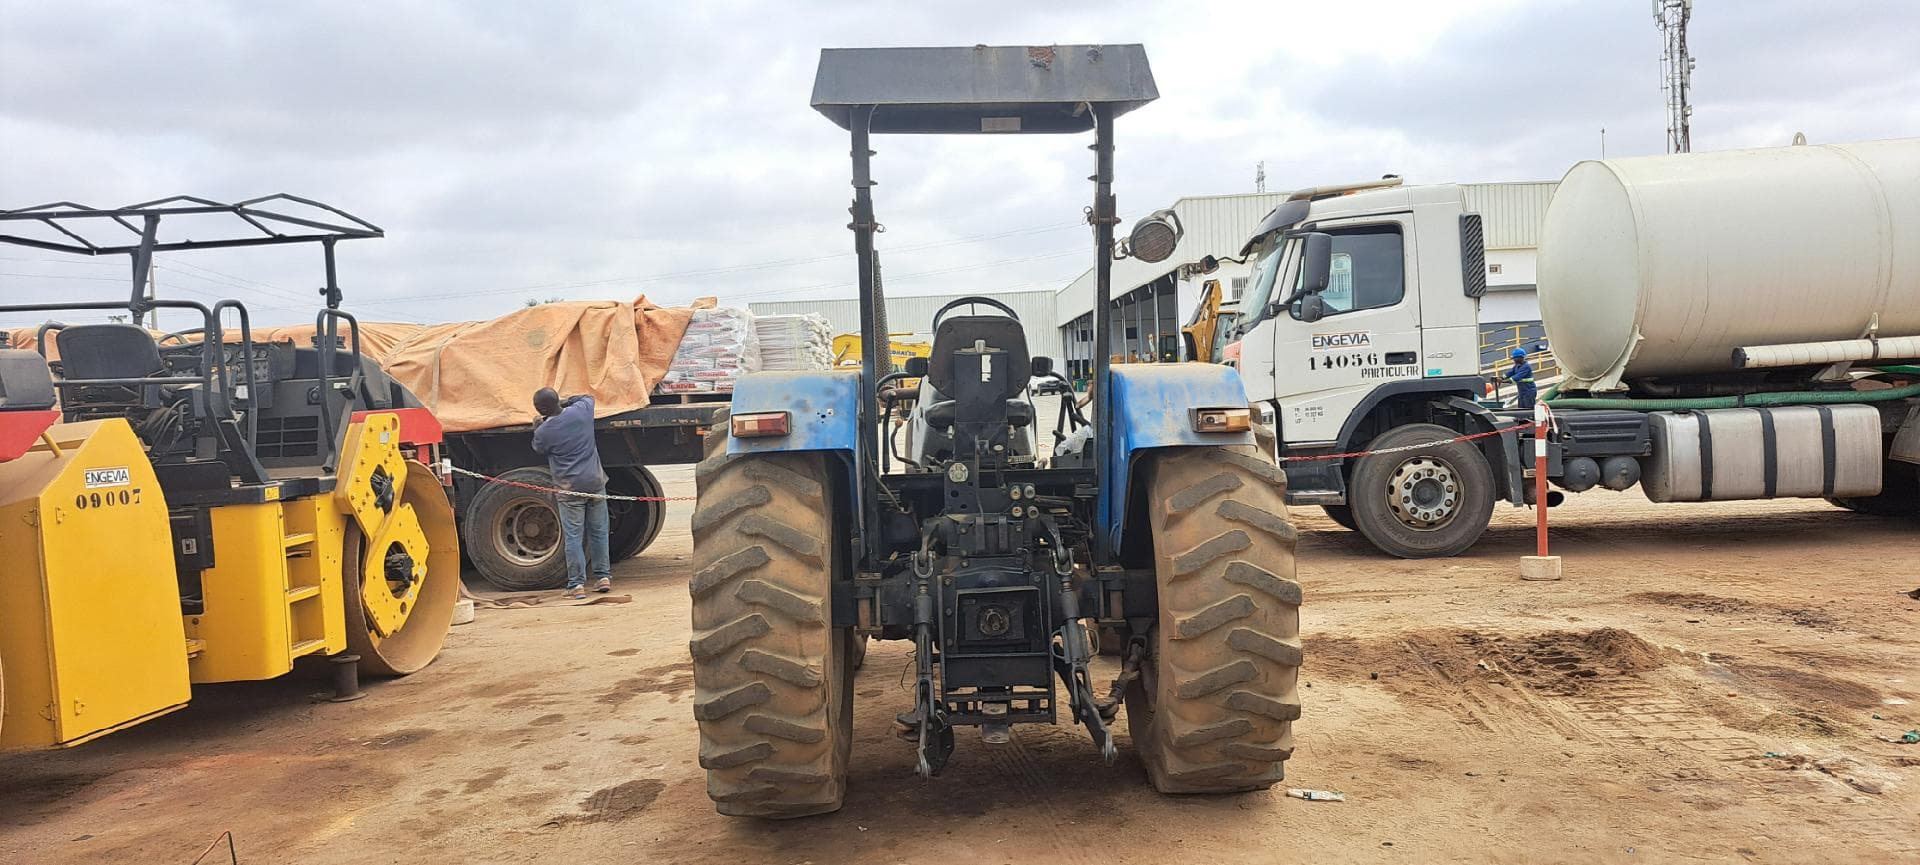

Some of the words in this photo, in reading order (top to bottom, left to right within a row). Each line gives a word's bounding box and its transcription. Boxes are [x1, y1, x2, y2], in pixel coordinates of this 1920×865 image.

[1312, 333, 1370, 348] ENGEVIA
[1308, 353, 1378, 371] 14056
[1361, 365, 1419, 379] PARTICULAR
[85, 470, 129, 484] ENGEVIA
[76, 488, 141, 510] 09007
